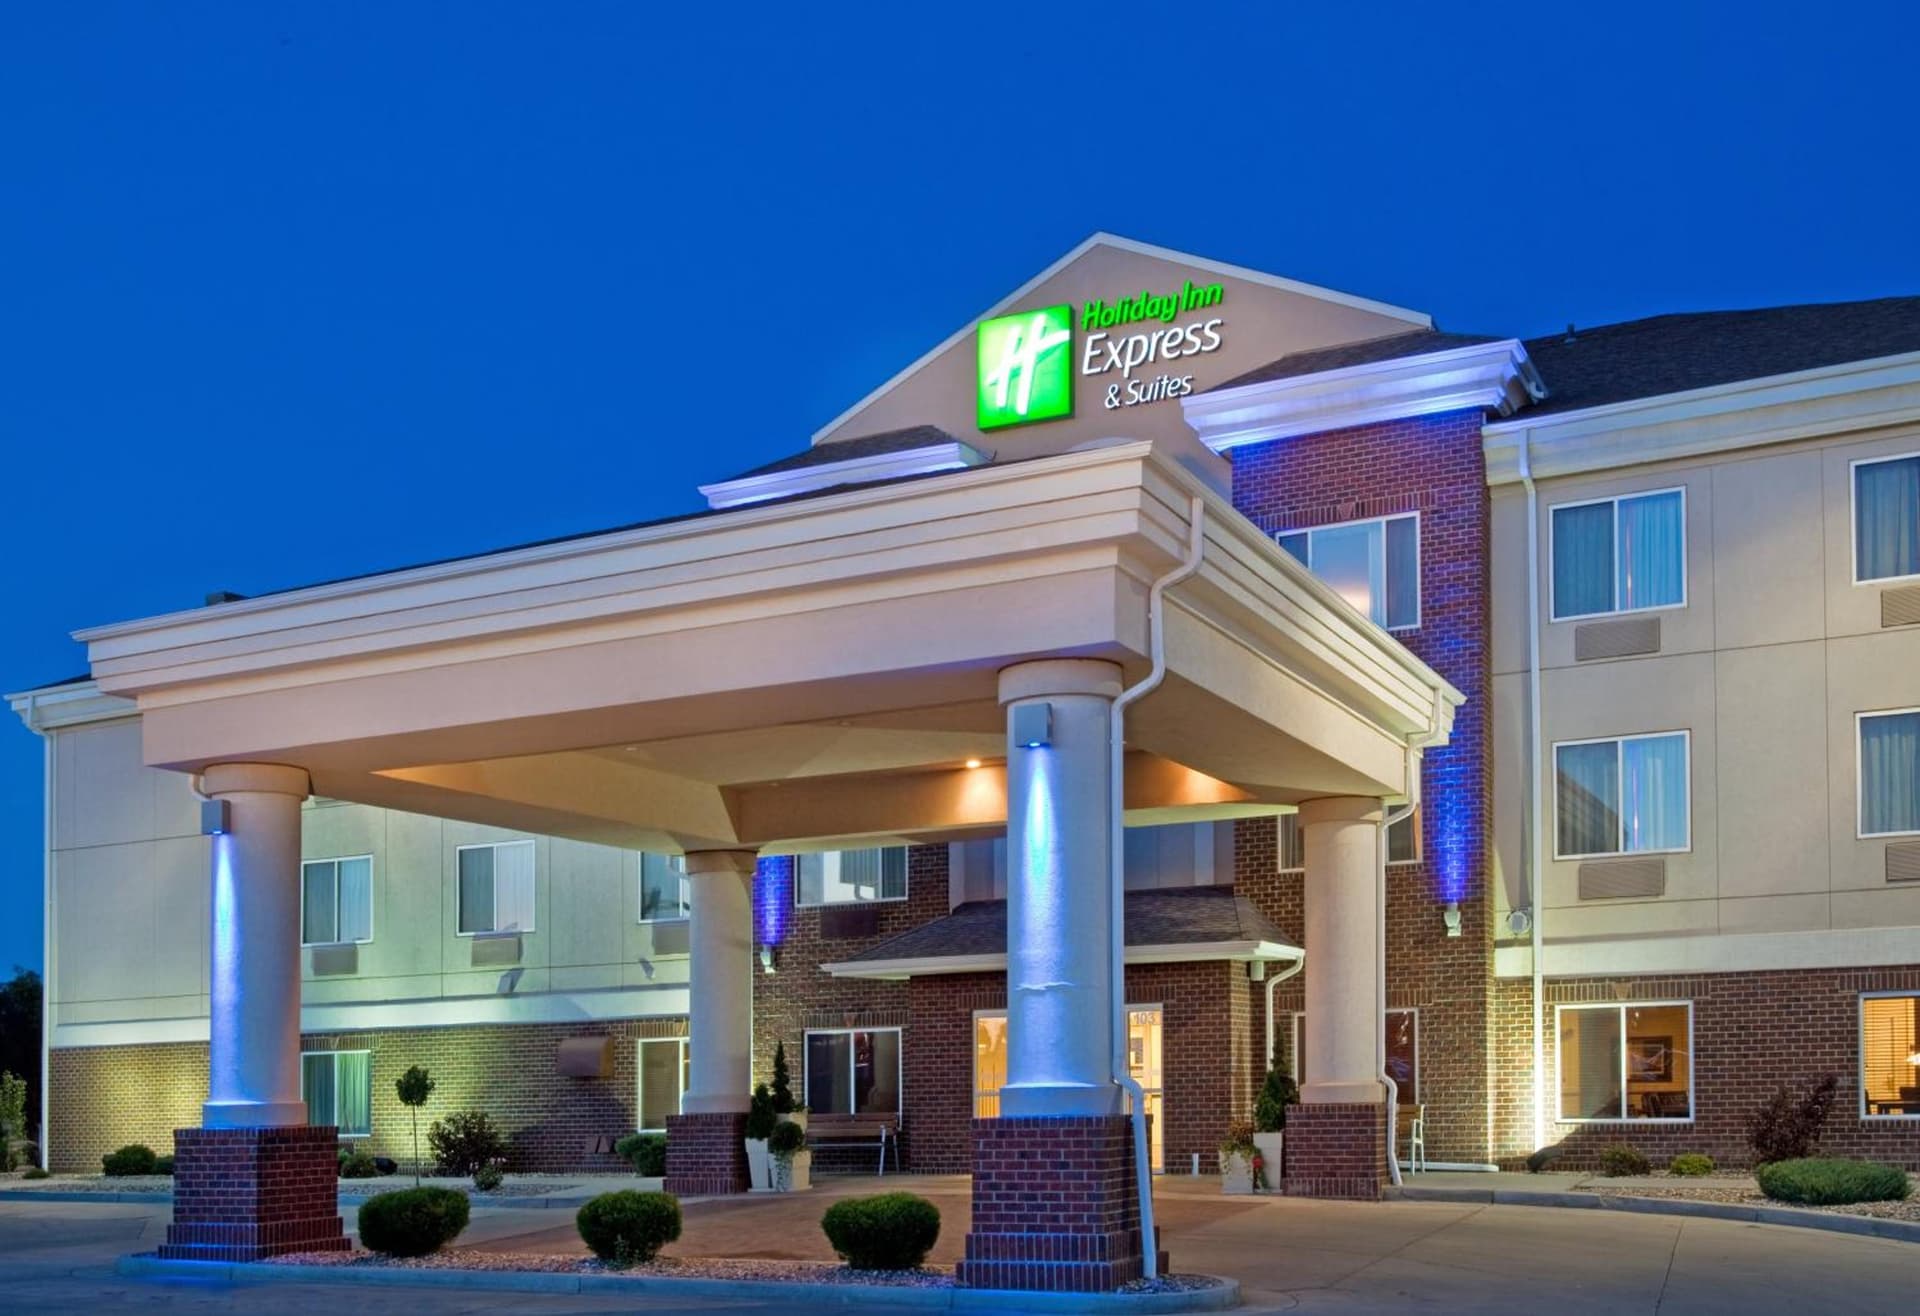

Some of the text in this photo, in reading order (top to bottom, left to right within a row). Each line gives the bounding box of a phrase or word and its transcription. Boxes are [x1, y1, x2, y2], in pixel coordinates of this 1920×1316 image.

[1082, 280, 1223, 331] Holiday Inn
[1082, 319, 1222, 377] Express
[1104, 375, 1193, 409] & Suites
